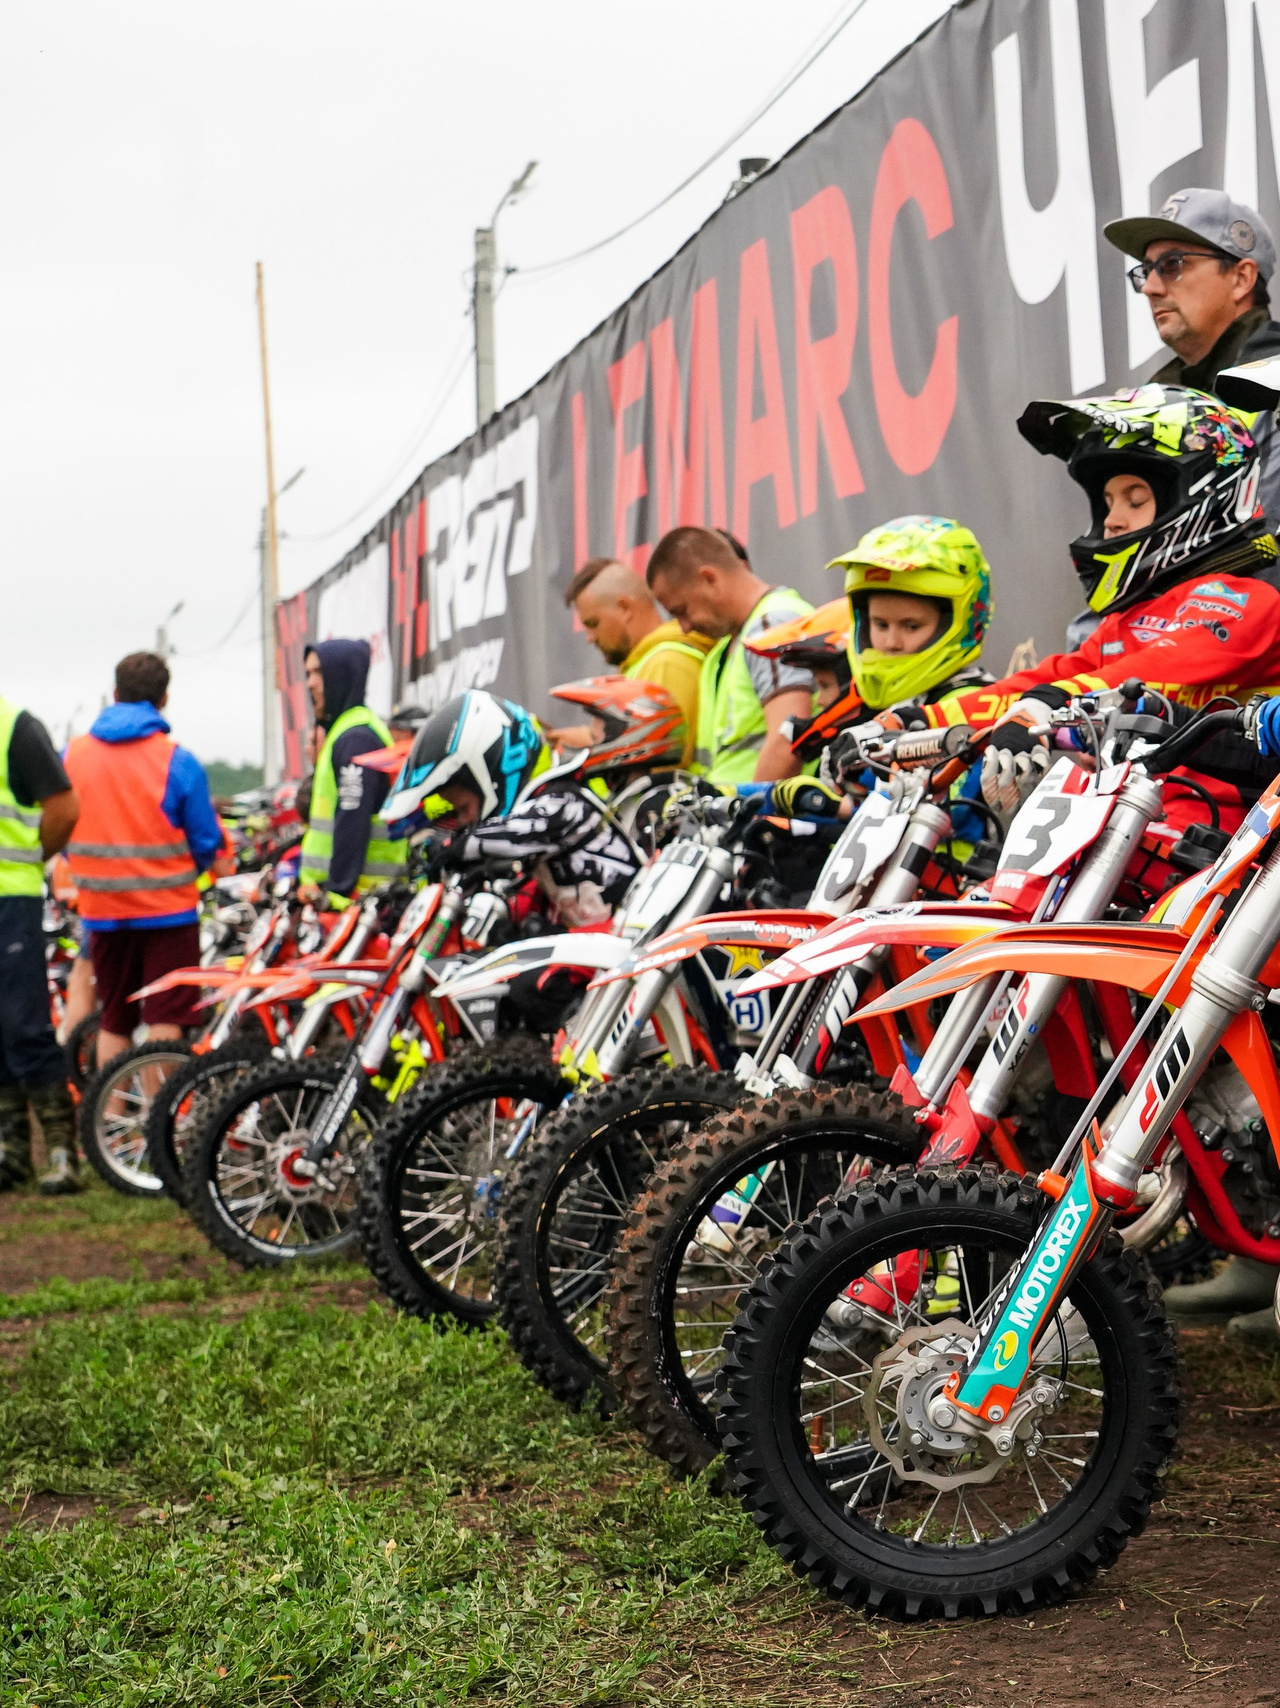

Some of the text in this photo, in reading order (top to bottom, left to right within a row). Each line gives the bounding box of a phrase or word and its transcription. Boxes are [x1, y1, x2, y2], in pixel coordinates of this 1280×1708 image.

[825, 818, 885, 901] 5
[1002, 796, 1072, 872] 3
[1008, 1195, 1089, 1330] MOTOREX
